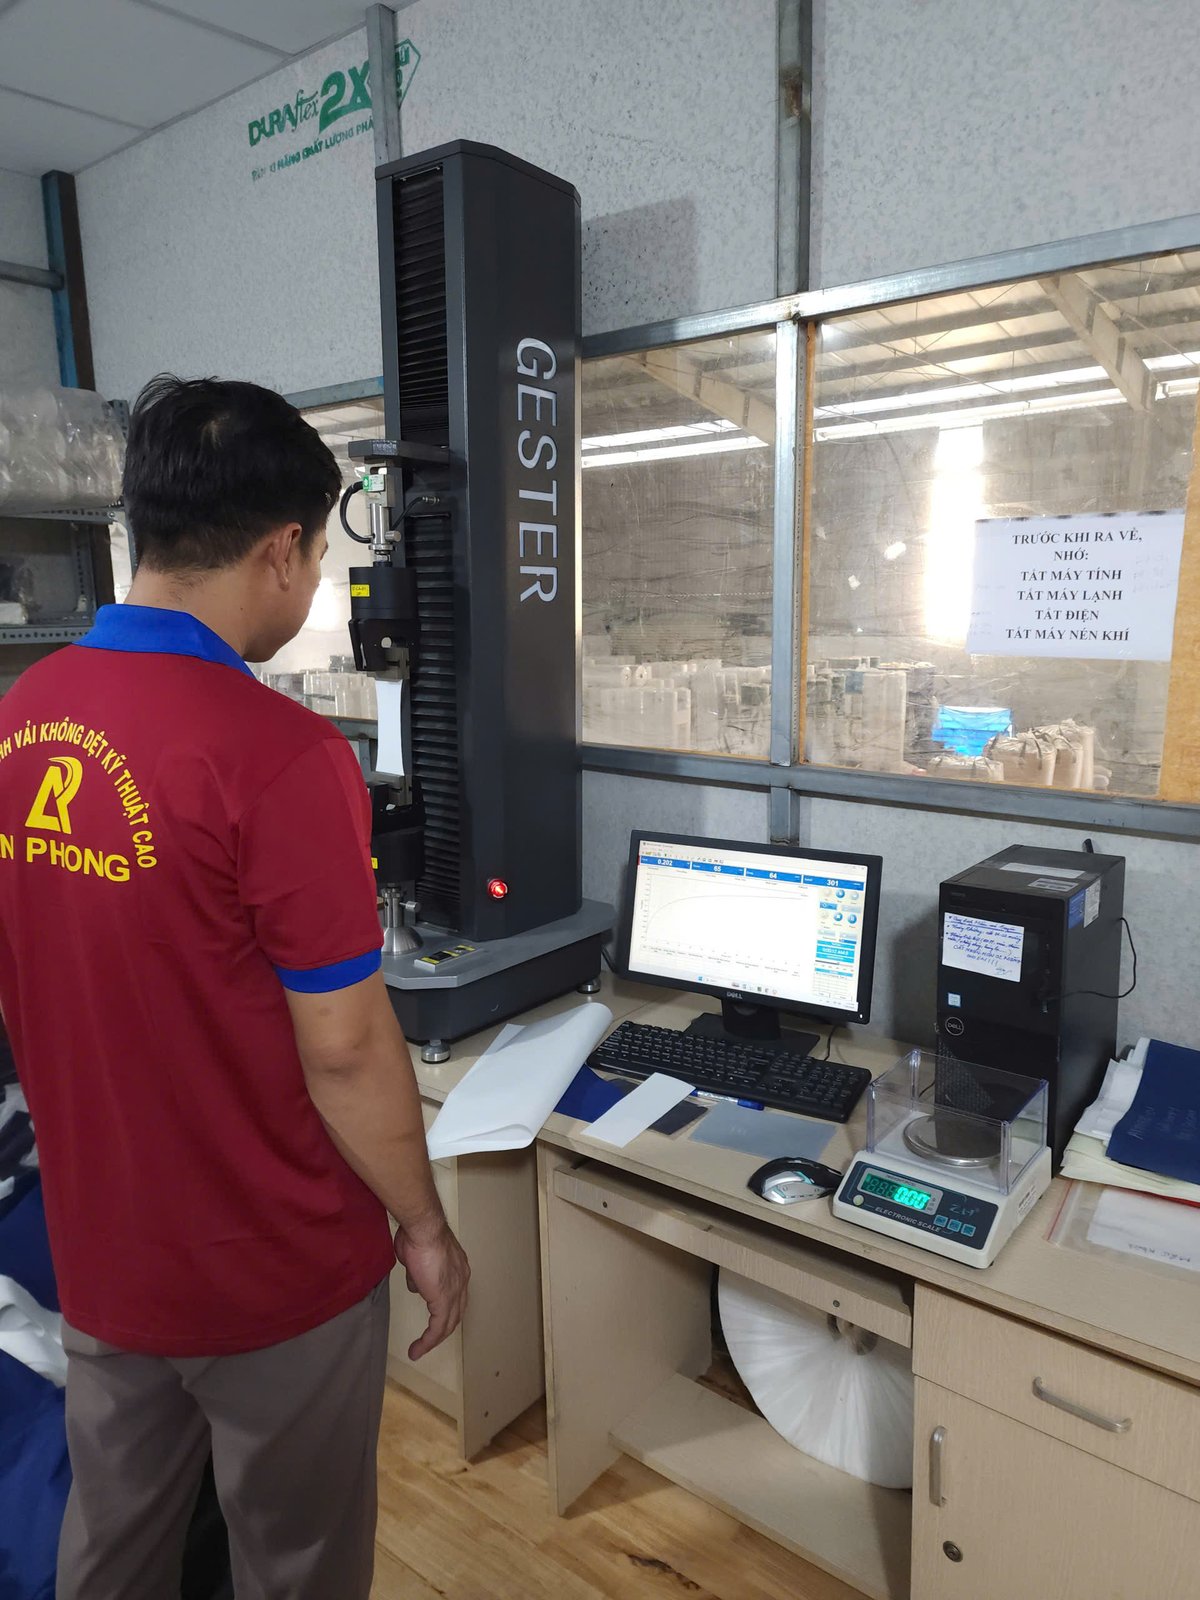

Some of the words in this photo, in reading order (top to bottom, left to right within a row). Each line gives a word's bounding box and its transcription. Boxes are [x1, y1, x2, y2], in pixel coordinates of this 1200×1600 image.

[516, 337, 558, 603] GESTER
[1012, 530, 1061, 545] TRƯỚC
[1063, 532, 1091, 543] KHI
[1094, 531, 1114, 543] RA
[1053, 547, 1090, 561] NHỚ:
[1050, 567, 1083, 581] MÁY
[1086, 566, 1123, 580] TÍNH
[1046, 587, 1079, 601] MÁY
[1082, 590, 1123, 604] LẠNH
[1065, 608, 1100, 623] ĐIỆN
[1034, 626, 1066, 640] MÁY
[1069, 627, 1099, 641] NÉN
[1101, 627, 1131, 641] KHÍ
[14, 719, 37, 749] VẢI
[39, 716, 85, 746] KHÔNG
[82, 730, 109, 759] DỆT
[101, 748, 128, 775] KỸ
[114, 769, 150, 826] THUẬT
[0, 832, 15, 860] N
[26, 836, 131, 883] PHONG
[132, 830, 158, 869] CAO
[657, 858, 674, 867] 0.202
[826, 879, 839, 888] 301
[874, 1206, 918, 1226] ELECTRONIC
[916, 1219, 943, 1234] SCALE
